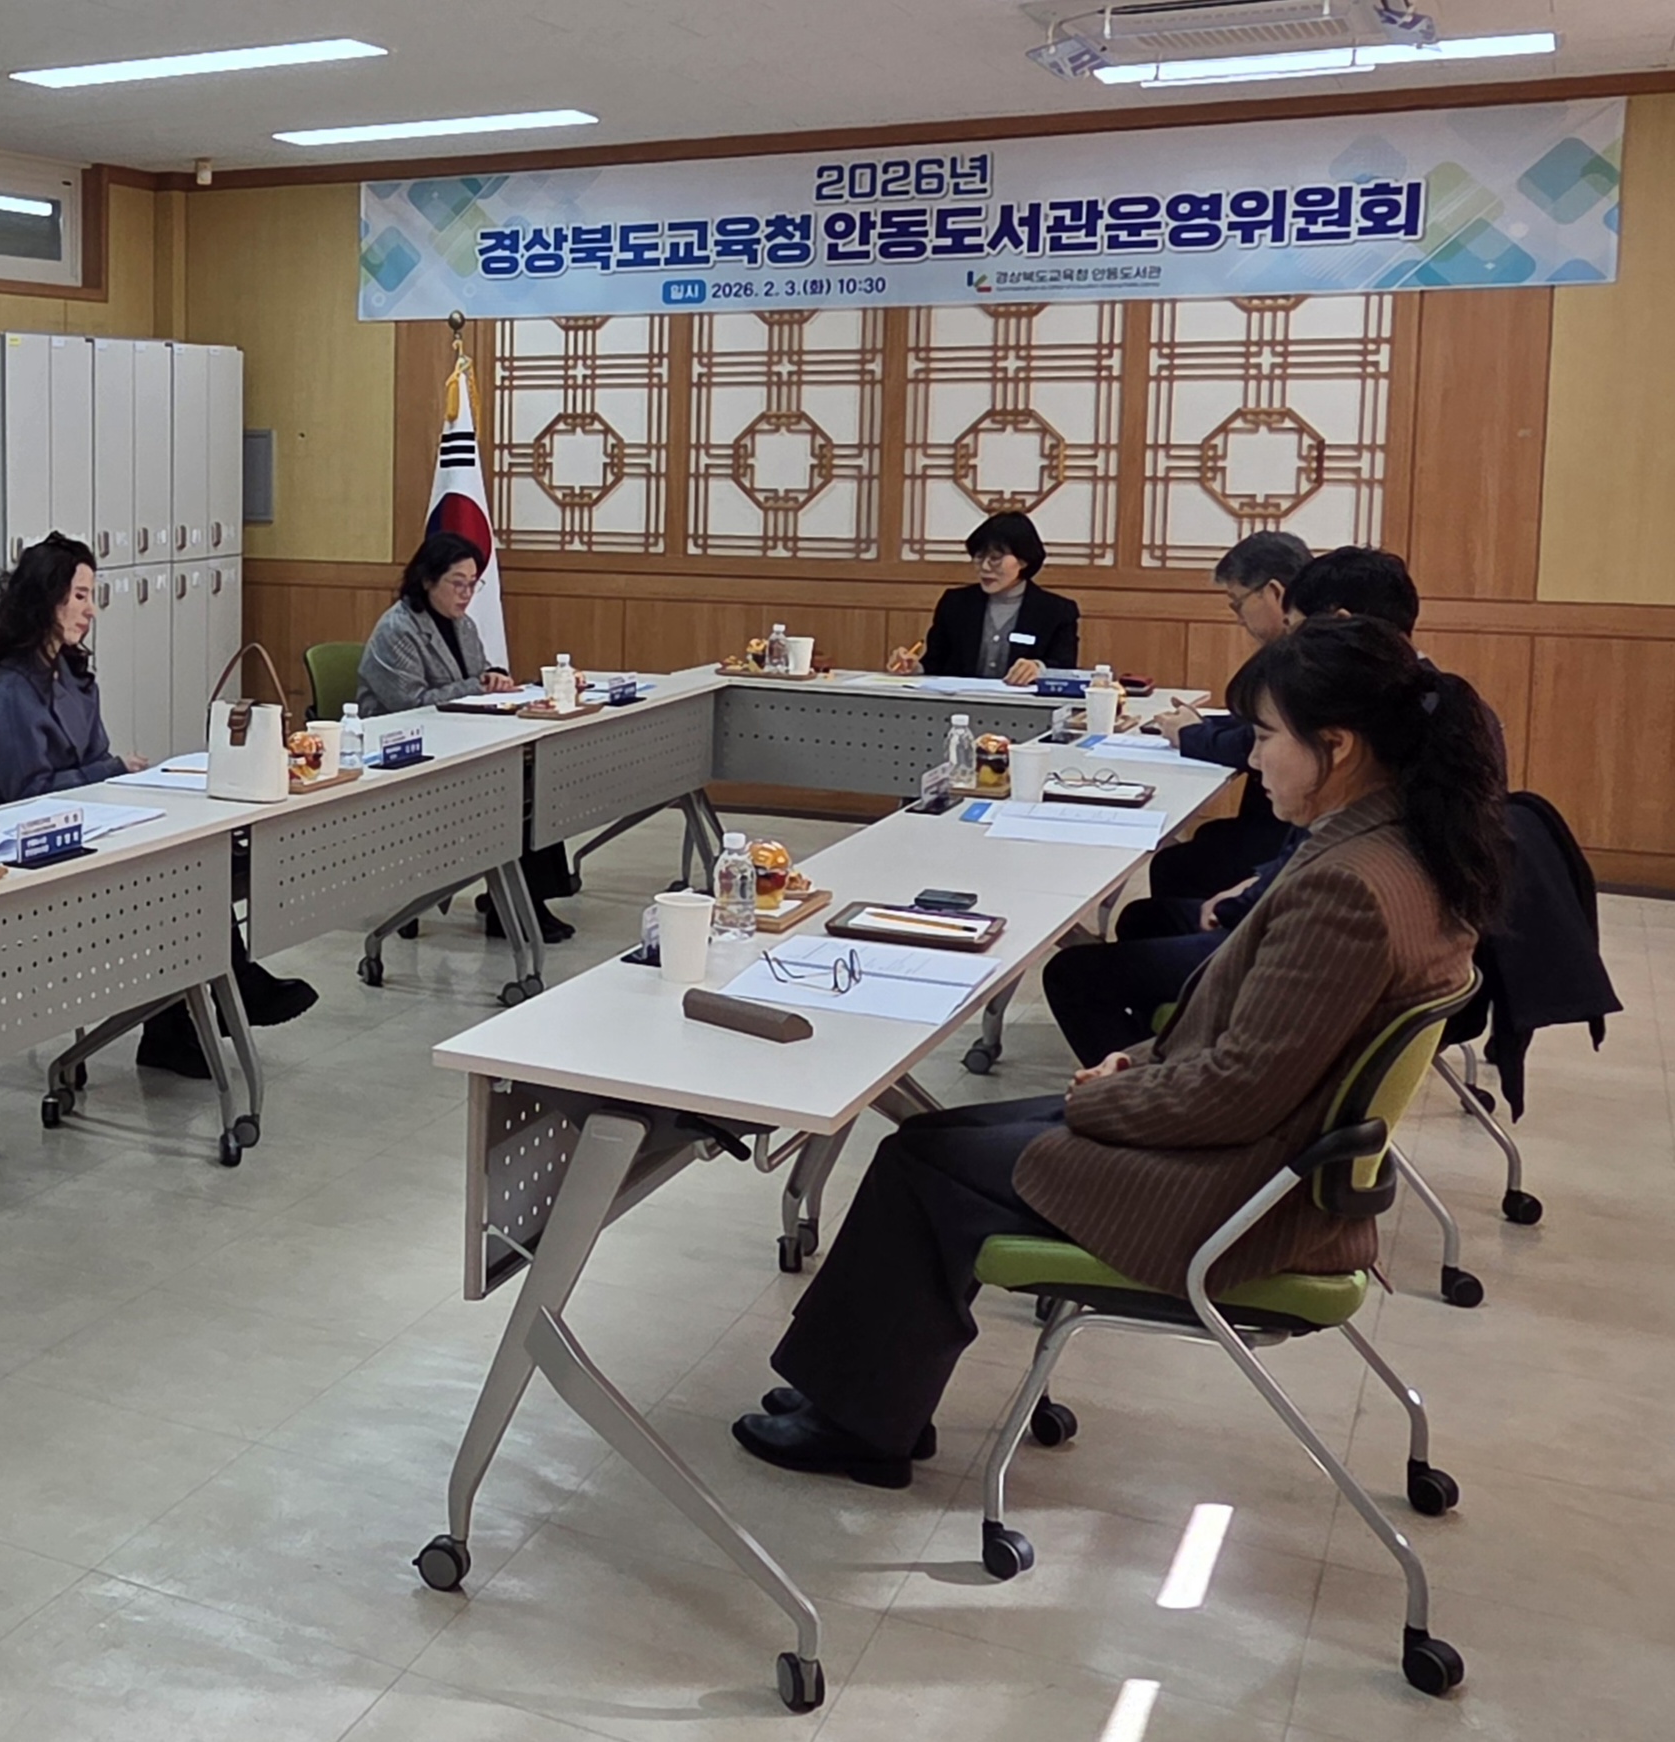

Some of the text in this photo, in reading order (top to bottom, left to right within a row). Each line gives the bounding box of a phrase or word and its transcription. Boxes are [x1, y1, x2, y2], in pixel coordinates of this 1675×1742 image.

[815, 153, 989, 201] 2026년
[478, 182, 1422, 275] 경상북도교육청 안동도서관운영위원회
[670, 283, 699, 300] 일시
[711, 282, 759, 299] 2026.
[763, 280, 780, 297] 2.
[837, 276, 887, 294] 10:30
[995, 265, 1162, 285] 경상북도교육청 안동도서관
